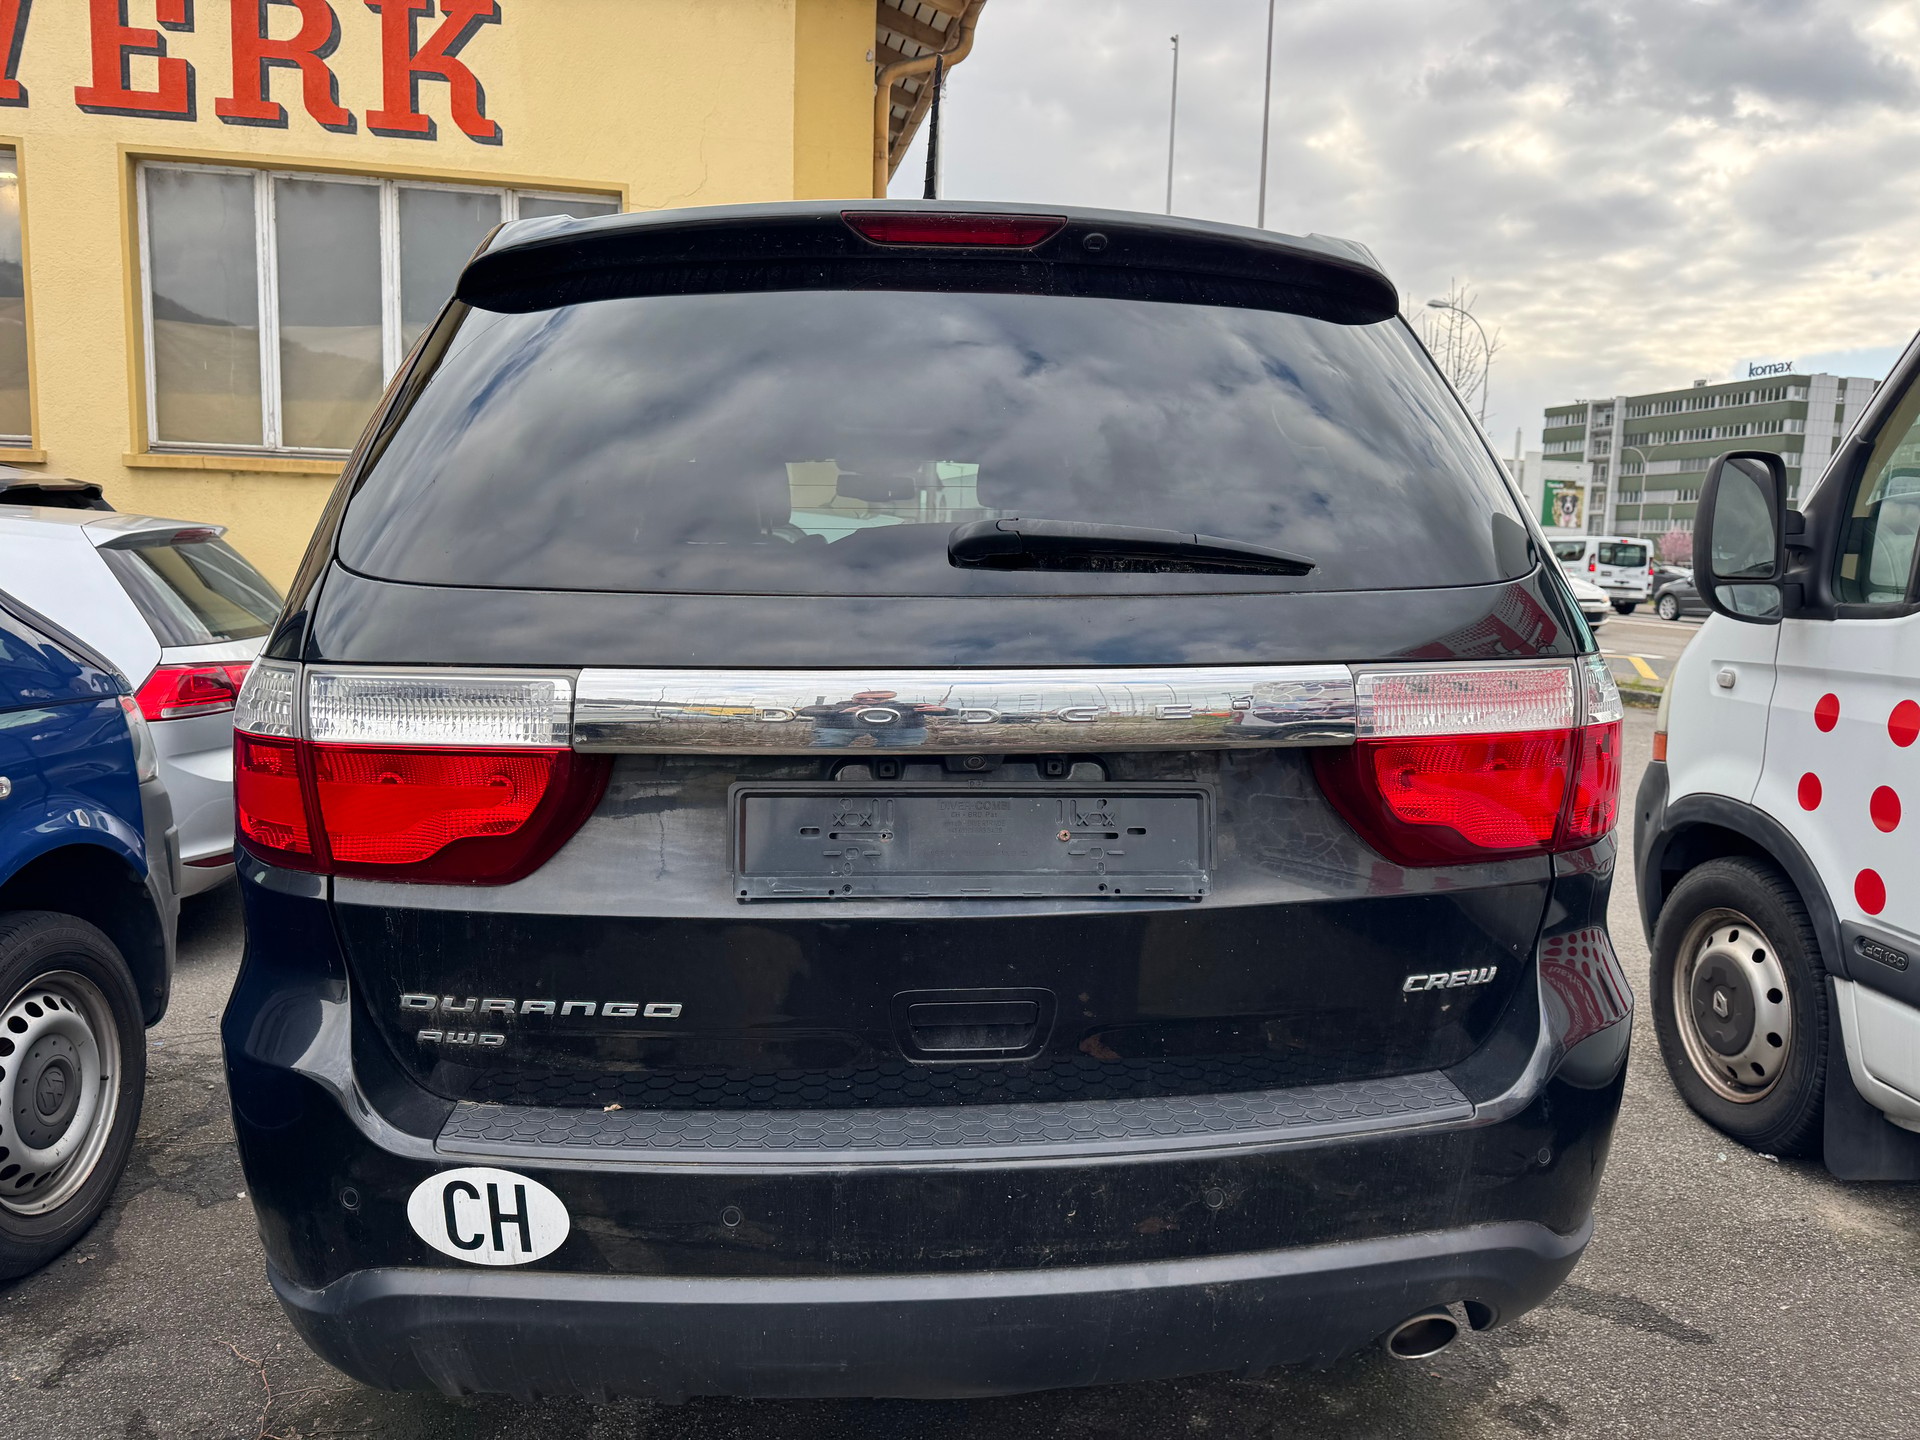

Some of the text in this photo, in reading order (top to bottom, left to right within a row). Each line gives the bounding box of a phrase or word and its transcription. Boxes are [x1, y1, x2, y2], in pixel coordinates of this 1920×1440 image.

[0, 0, 503, 146] ERK
[1748, 361, 1793, 378] komax
[752, 703, 1193, 725] DODGE
[1884, 951, 1906, 967] 100
[1402, 964, 1497, 994] CREW
[400, 994, 683, 1019] DURANGO
[416, 1029, 507, 1047] AWD
[442, 1180, 533, 1253] CH
